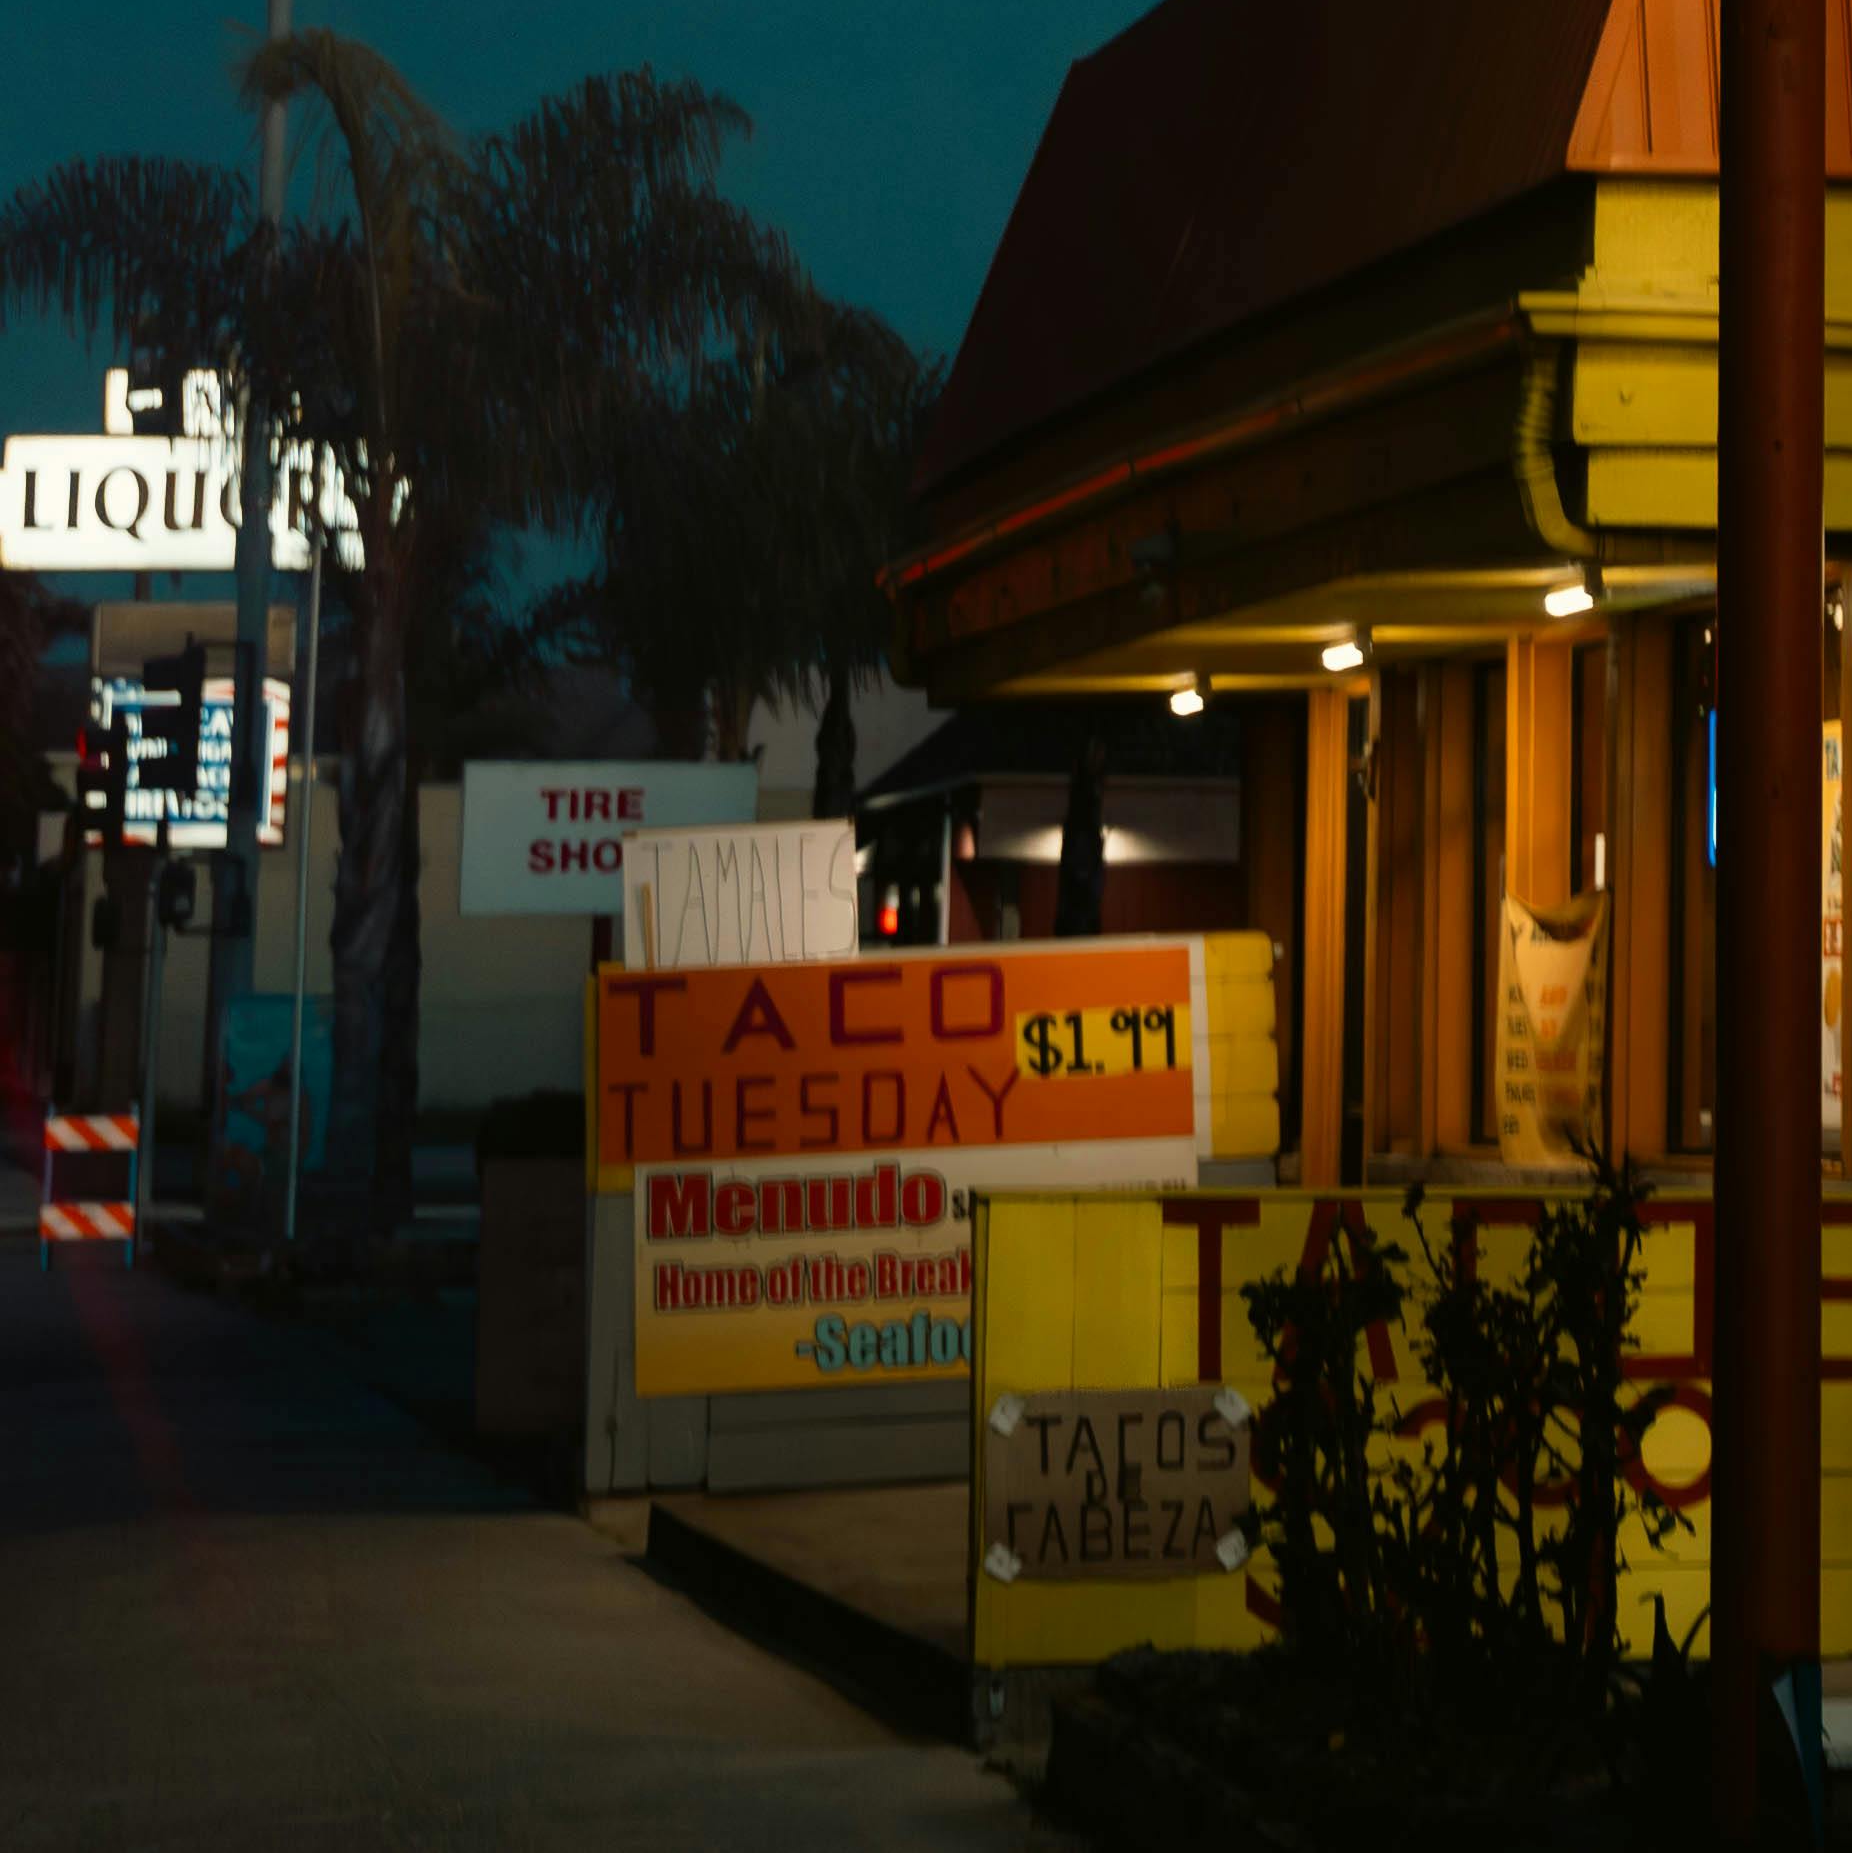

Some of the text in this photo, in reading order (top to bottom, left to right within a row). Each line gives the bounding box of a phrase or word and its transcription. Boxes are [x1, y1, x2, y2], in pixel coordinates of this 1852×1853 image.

[24, 465, 312, 543] LIQU
[541, 787, 643, 822] TIRE
[640, 830, 857, 969] TAMALES
[608, 964, 1005, 1057] TACO
[1023, 1005, 1176, 1078] $1.99
[608, 1064, 1020, 1160] TUESDAY
[646, 1160, 946, 1243] Menudo
[655, 1259, 762, 1313] Home
[763, 1255, 803, 1307] of
[805, 1253, 871, 1306] the
[1023, 1410, 1236, 1476] TACOS
[1006, 1495, 1218, 1564] CABEZA
